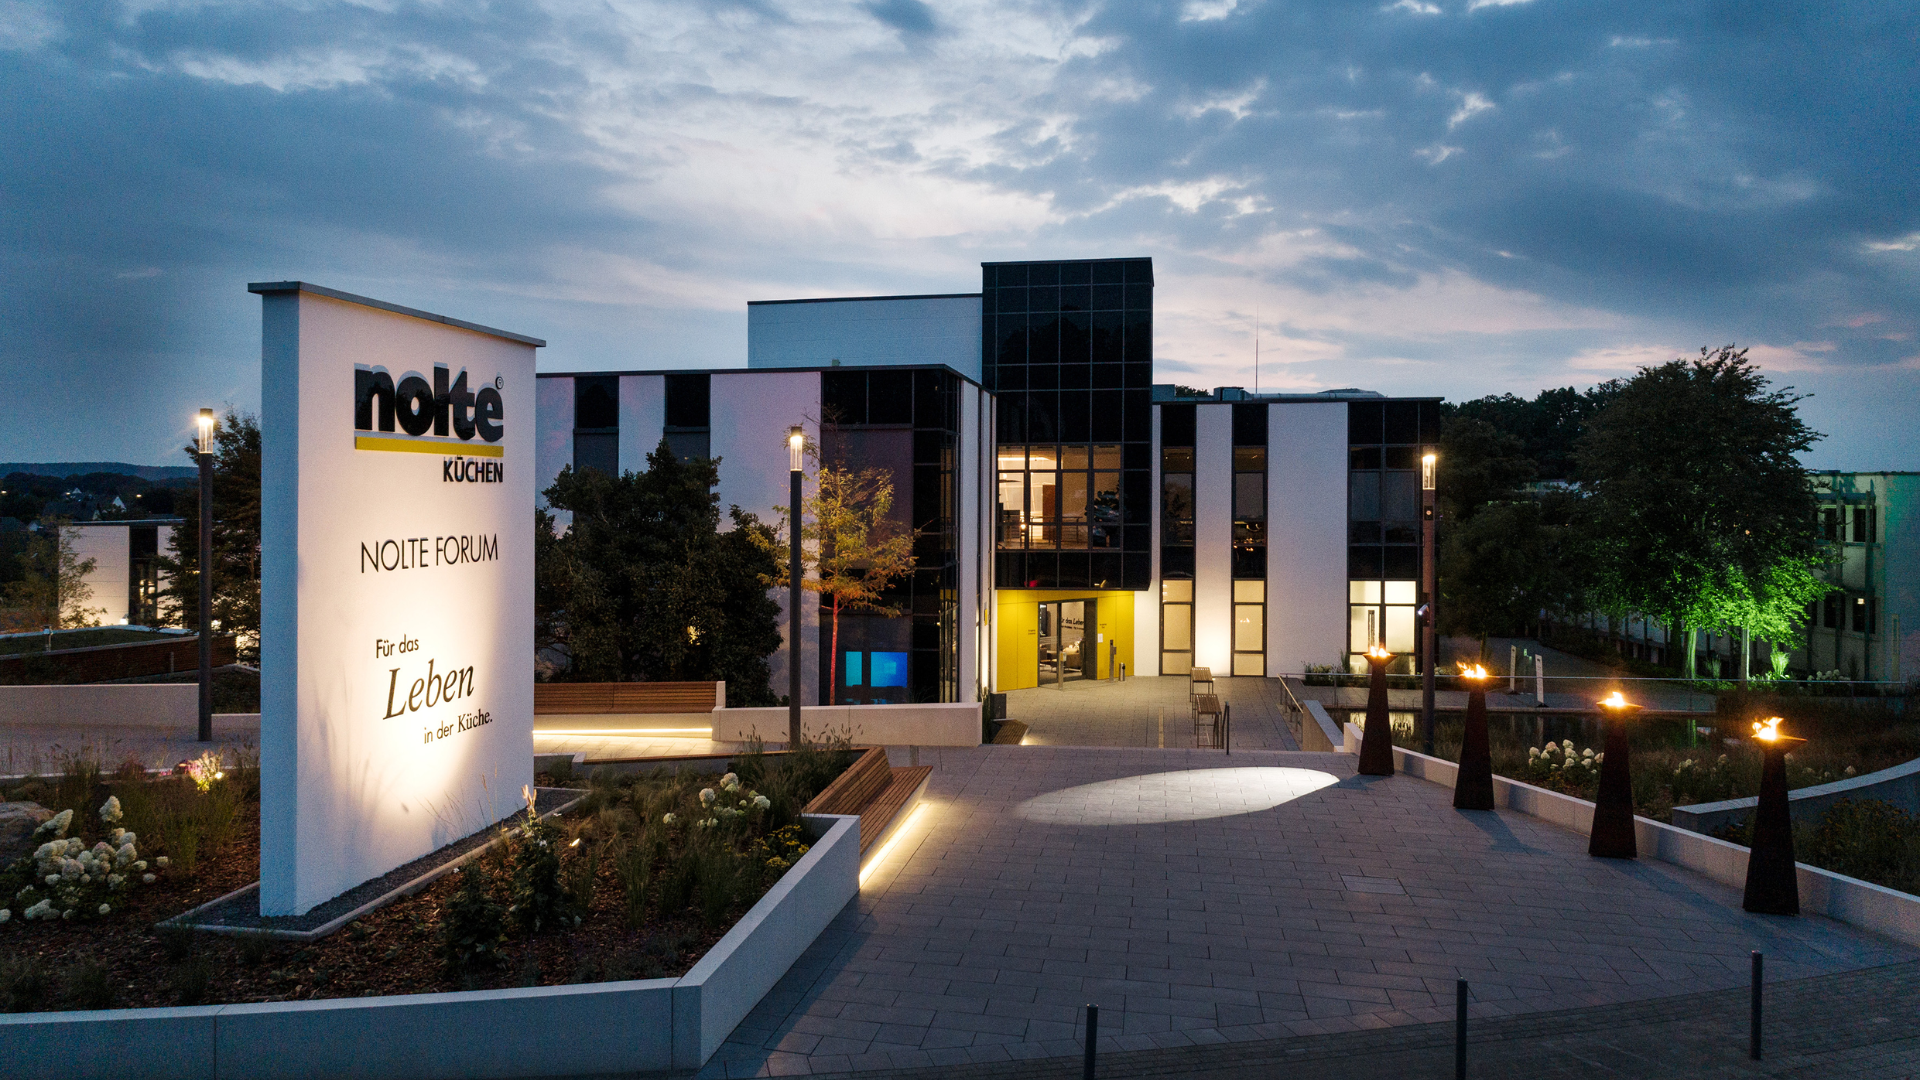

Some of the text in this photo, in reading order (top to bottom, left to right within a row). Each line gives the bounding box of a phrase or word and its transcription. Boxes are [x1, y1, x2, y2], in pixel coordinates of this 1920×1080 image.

[355, 366, 503, 442] nolte
[443, 455, 504, 482] KÜCHEN
[361, 533, 499, 573] NOLTE FORUM
[376, 633, 419, 659] Für das
[382, 658, 474, 720] Leben
[424, 708, 493, 744] in der Küche.
